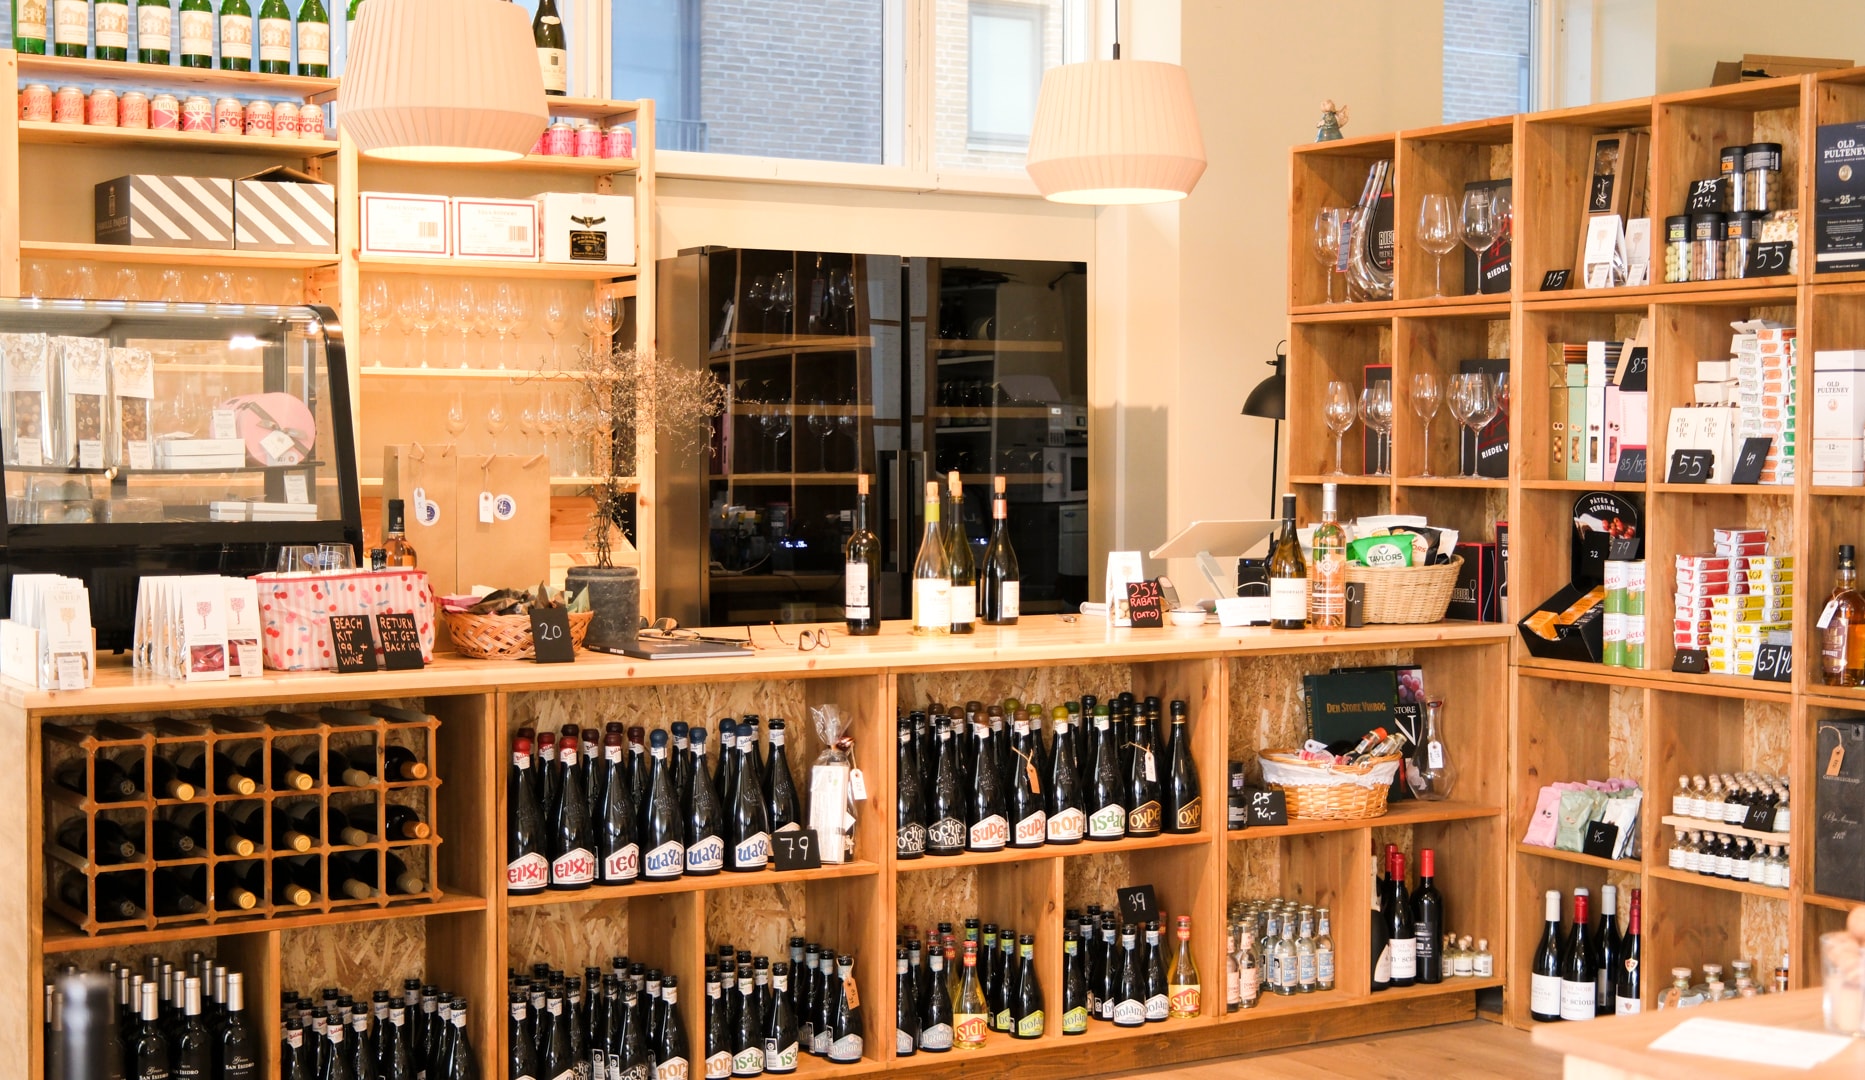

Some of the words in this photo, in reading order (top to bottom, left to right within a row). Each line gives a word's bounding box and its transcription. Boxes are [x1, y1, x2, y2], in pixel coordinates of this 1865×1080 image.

[1837, 139, 1856, 149] OLD
[1824, 147, 1865, 159] PULTENEY
[1839, 194, 1850, 204] 25
[1757, 243, 1787, 270] 55
[1486, 263, 1509, 280] RIEDEL
[1546, 271, 1565, 287] 115
[1817, 386, 1849, 394] PULTENEY
[1481, 444, 1503, 460] RIEDEL
[1678, 453, 1705, 477] 55
[1368, 552, 1403, 563] TAYLORS
[1128, 582, 1158, 598] 25%
[1130, 596, 1159, 607] RABAT
[333, 617, 363, 631] BEACH
[380, 617, 414, 630] RETURN
[337, 630, 353, 642] KIT
[400, 630, 417, 641] GET
[539, 621, 563, 641] 20
[385, 641, 407, 653] BACK
[341, 653, 364, 666] WINE
[1326, 702, 1341, 714] DEN
[1341, 702, 1362, 713] STORE
[1363, 701, 1387, 712] VINBOG
[1393, 705, 1416, 714] STORE
[1752, 810, 1768, 824] 49
[779, 835, 809, 861] 79
[609, 850, 638, 875] LEÖ
[1128, 892, 1147, 912] 39
[238, 1061, 255, 1070] ISIDRO
